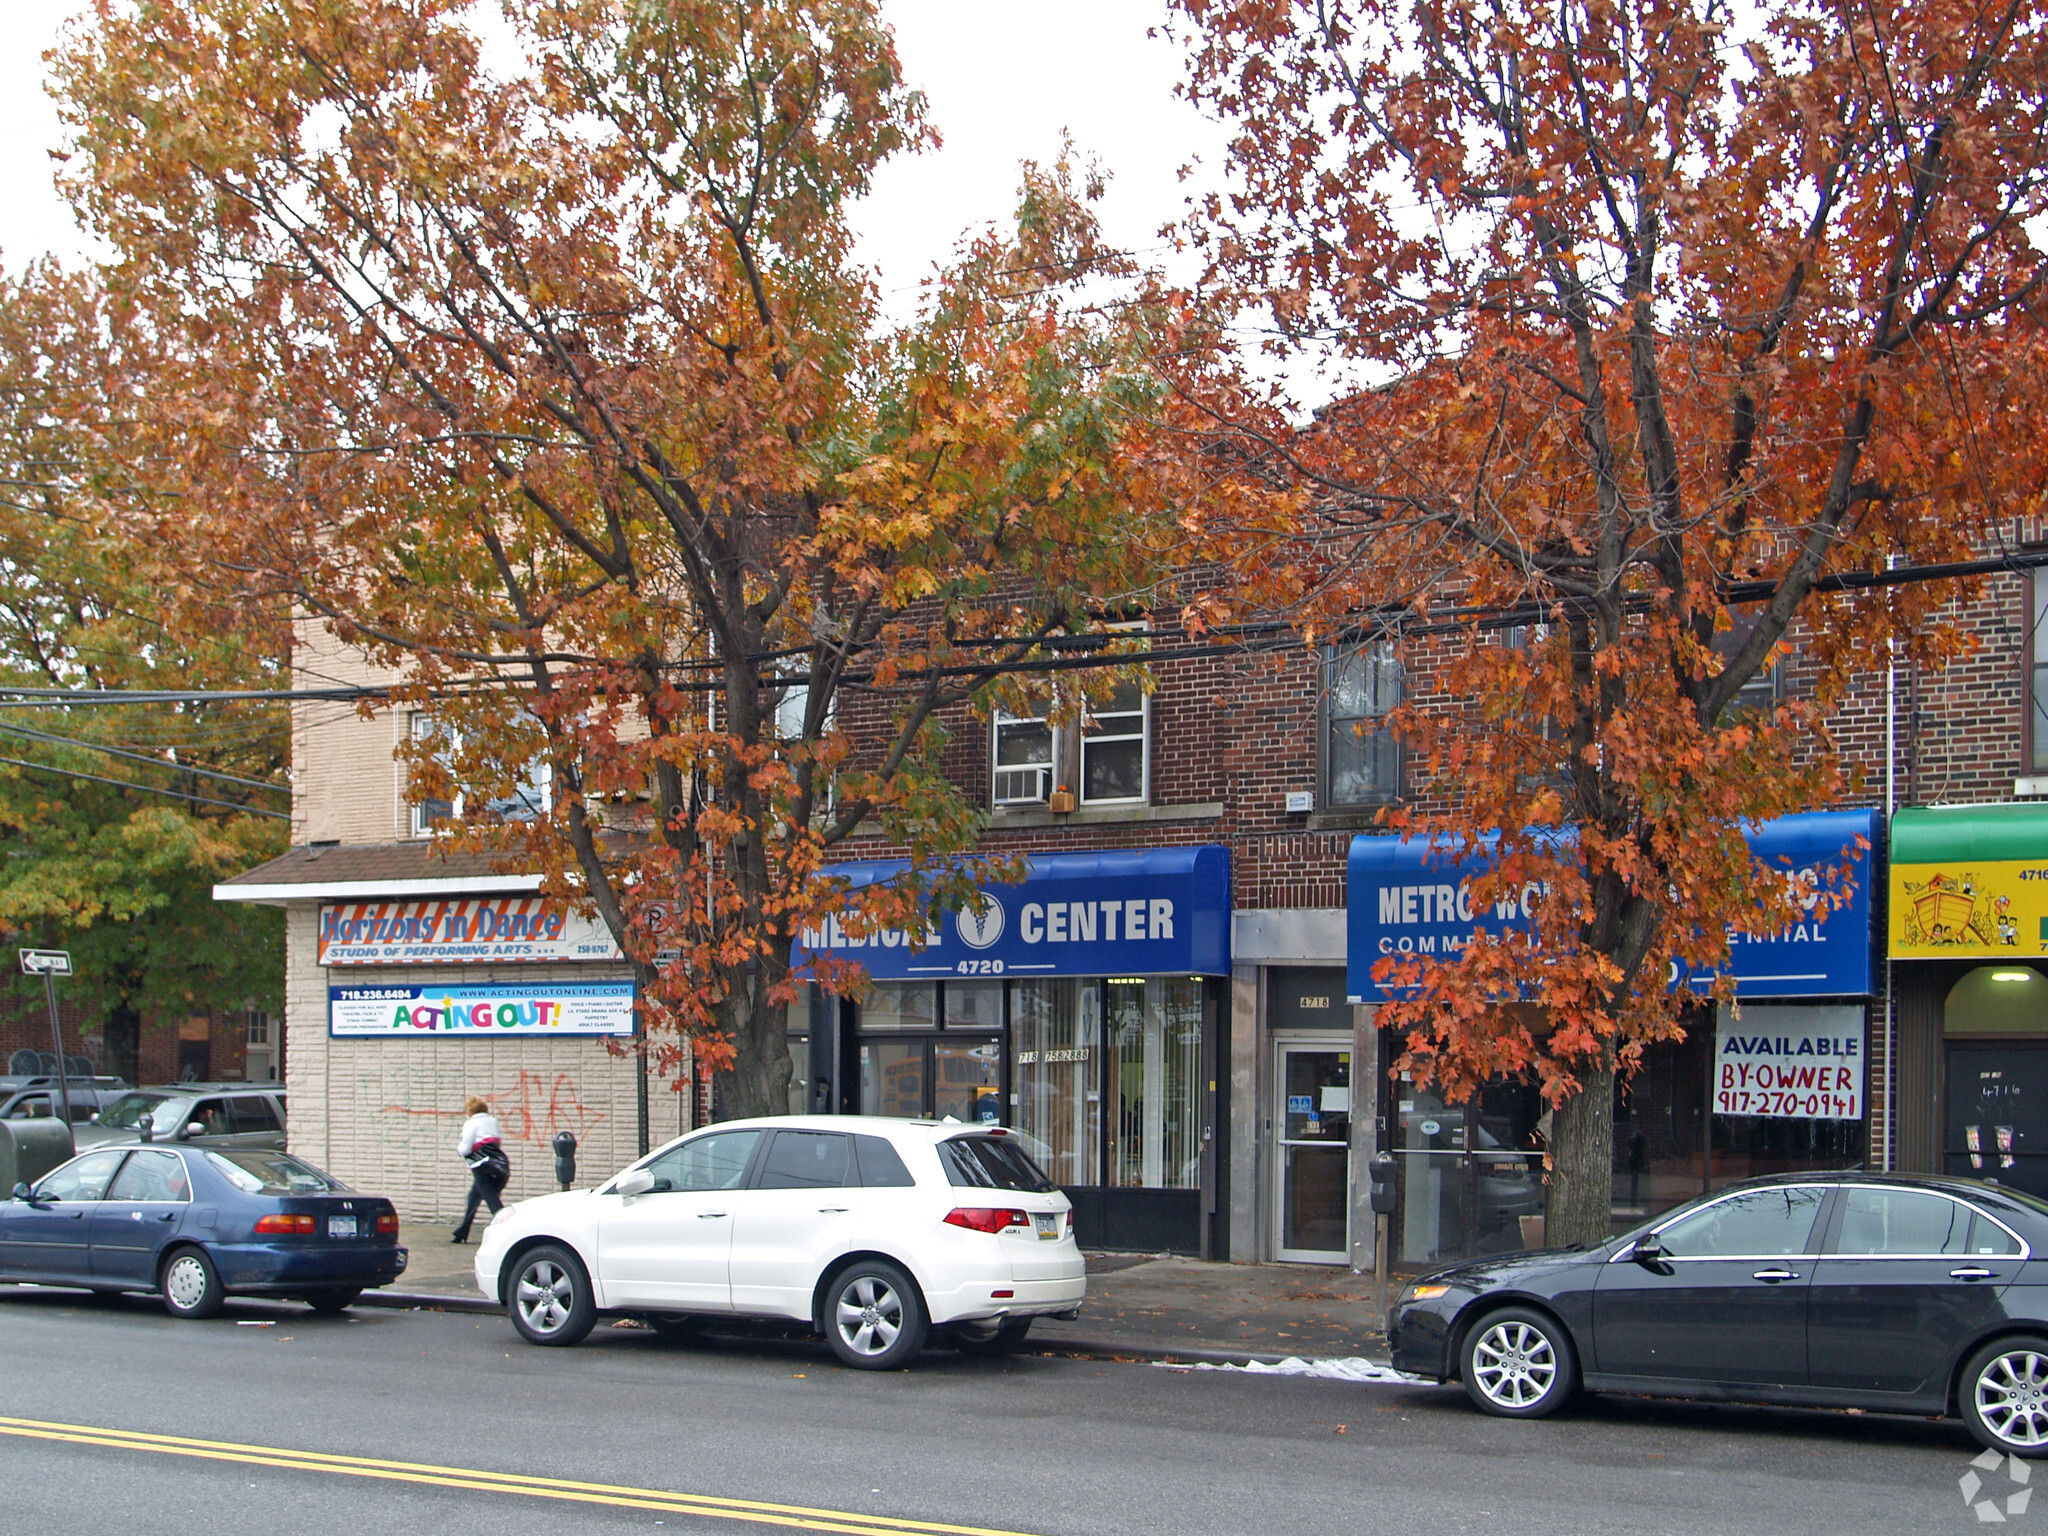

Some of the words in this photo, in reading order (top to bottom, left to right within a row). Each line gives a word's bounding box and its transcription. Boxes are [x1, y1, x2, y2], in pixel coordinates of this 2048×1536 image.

[2018, 869, 2048, 881] 4716
[1379, 884, 1481, 925] METRO
[323, 908, 435, 942] Horizons
[444, 907, 468, 938] in
[477, 907, 561, 937] Dance
[1020, 898, 1174, 944] CENTER
[330, 948, 379, 957] STUDIO
[384, 947, 401, 956] OF
[404, 945, 489, 957] PERFORMING
[493, 945, 533, 955] ARTS
[957, 959, 1004, 974] 4720
[340, 989, 412, 1000] 718.236.6494
[459, 987, 629, 997] WWW.ACTINGOUTONLINE.COM
[1301, 997, 1328, 1007] 4718
[393, 996, 492, 1031] ACTING
[496, 1000, 562, 1028] OUT!
[1722, 1036, 1858, 1056] AVAILABLE
[1019, 1053, 1037, 1063] 718
[1045, 1050, 1087, 1061] 7582888
[1721, 1062, 1853, 1091] BY-OWNER
[1718, 1091, 1855, 1116] 917-270-0941
